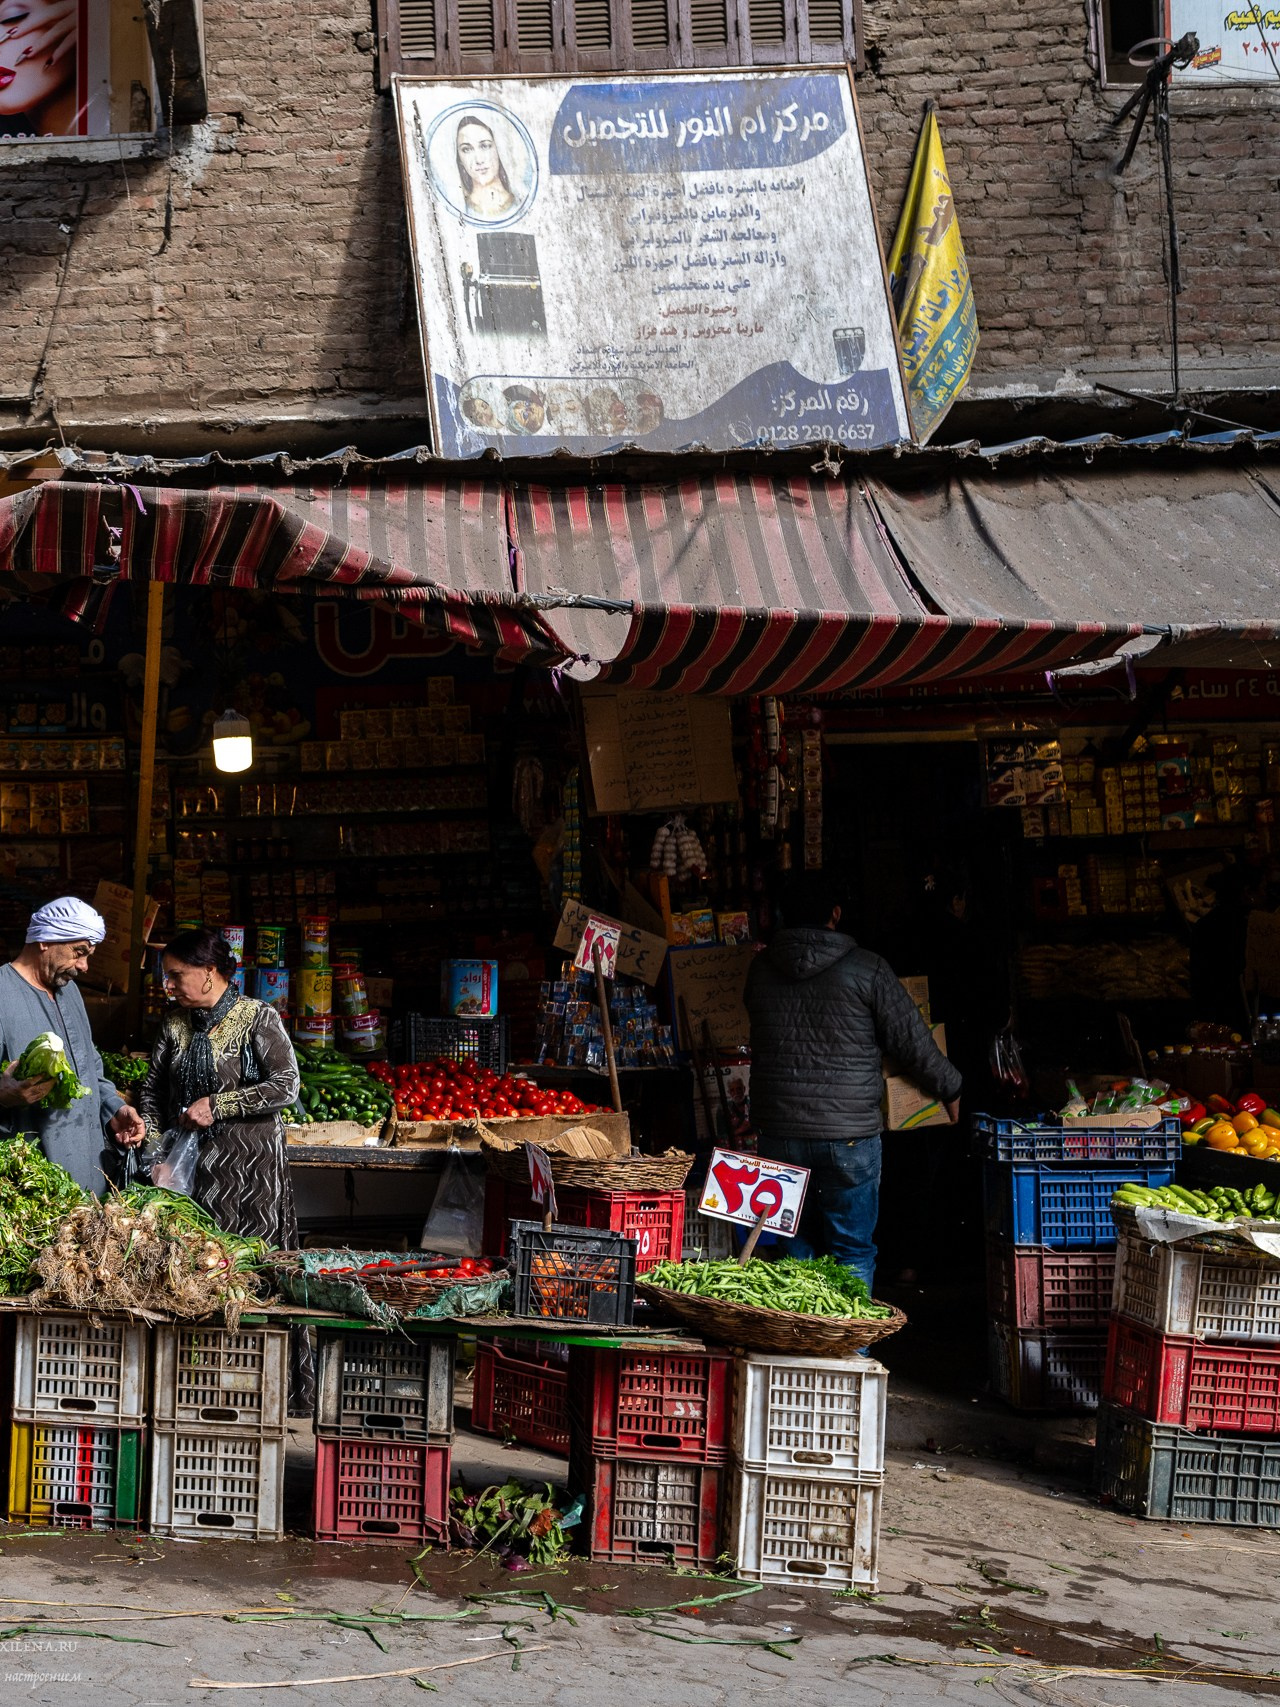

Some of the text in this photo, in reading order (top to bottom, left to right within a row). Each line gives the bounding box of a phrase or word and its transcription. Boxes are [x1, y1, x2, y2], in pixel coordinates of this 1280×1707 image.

[563, 102, 829, 148] مركز ام النور للتجميل
[835, 389, 868, 417] رقم
[758, 423, 874, 442] 0128 230 6637
[712, 1160, 783, 1219] ٣٥
